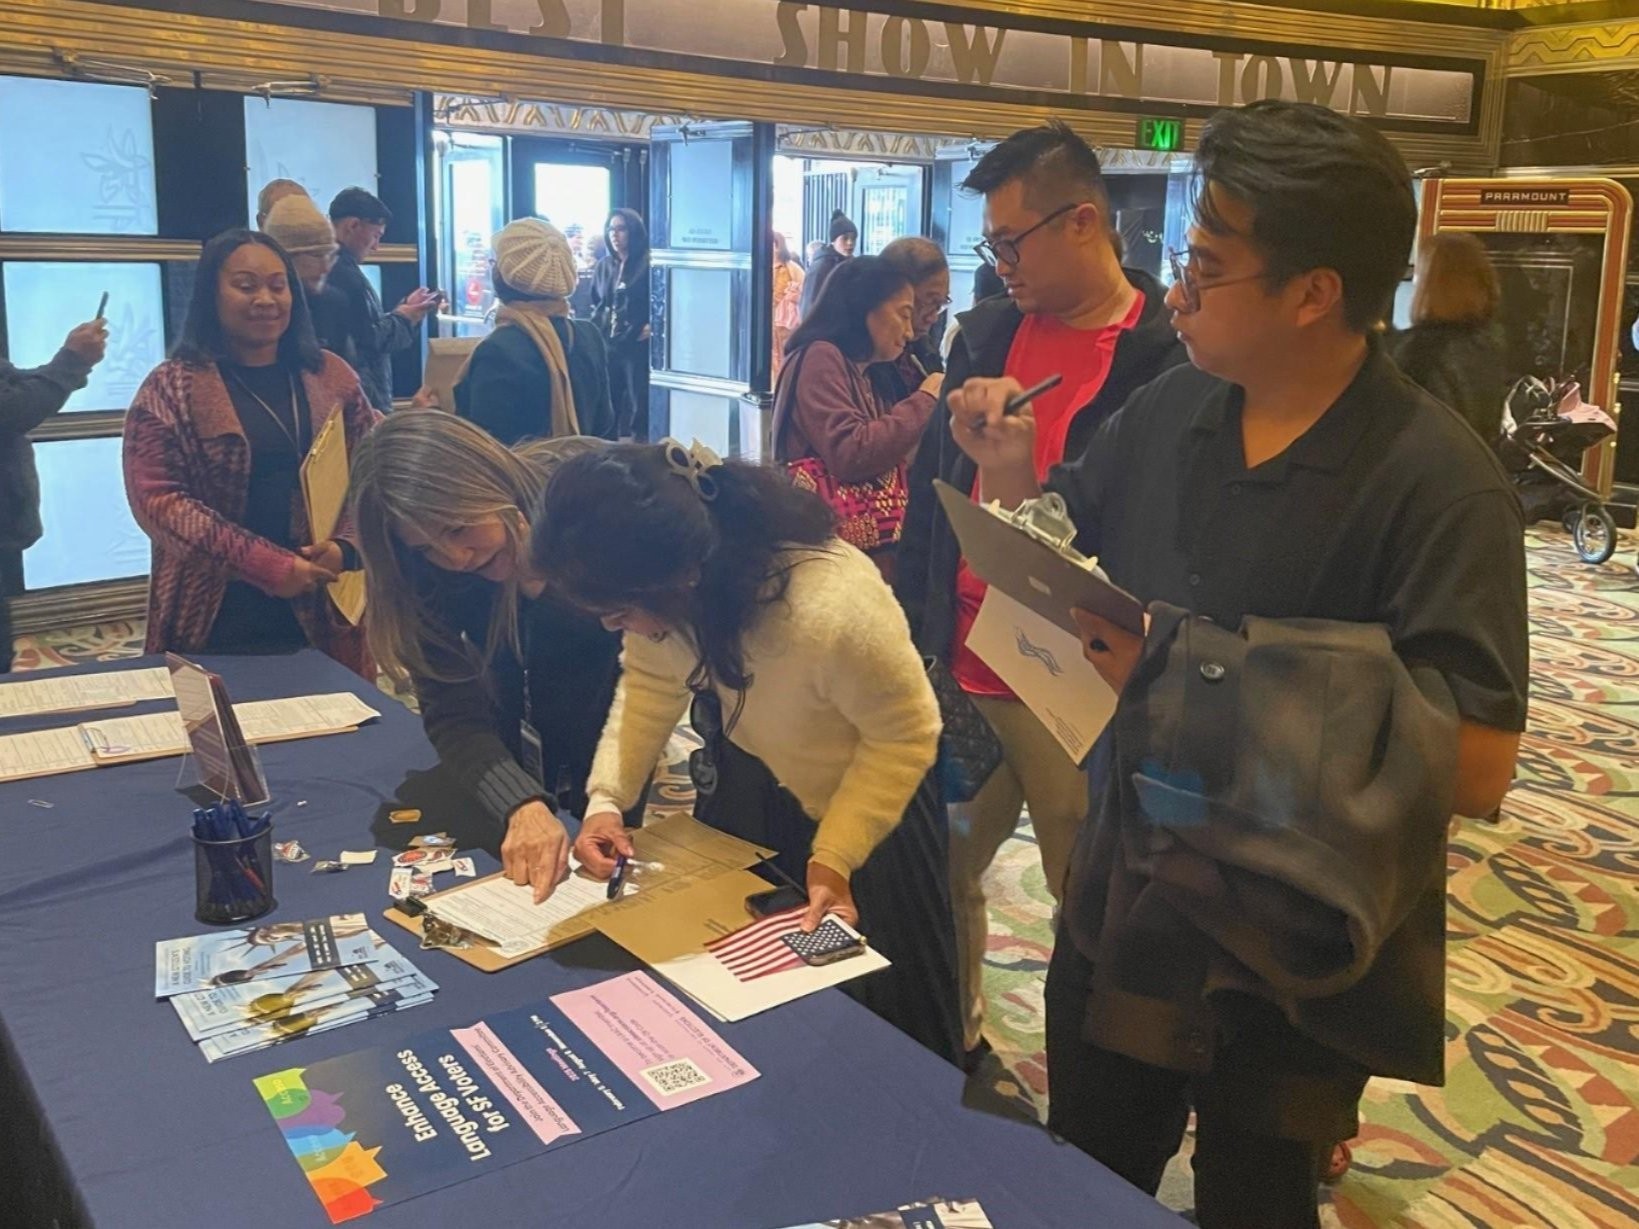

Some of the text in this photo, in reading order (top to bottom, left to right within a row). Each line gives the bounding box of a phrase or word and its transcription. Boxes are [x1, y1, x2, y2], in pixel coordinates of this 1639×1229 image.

[773, 1, 1007, 86] SHOW
[1070, 35, 1143, 98] IN
[1212, 51, 1392, 117] TOWN
[1141, 119, 1180, 149] EXIT
[1484, 191, 1567, 202] PARAMOUNT
[385, 1083, 437, 1141] Enhance
[396, 1048, 490, 1160] Language Access
[438, 1053, 510, 1132] for SF Voters
